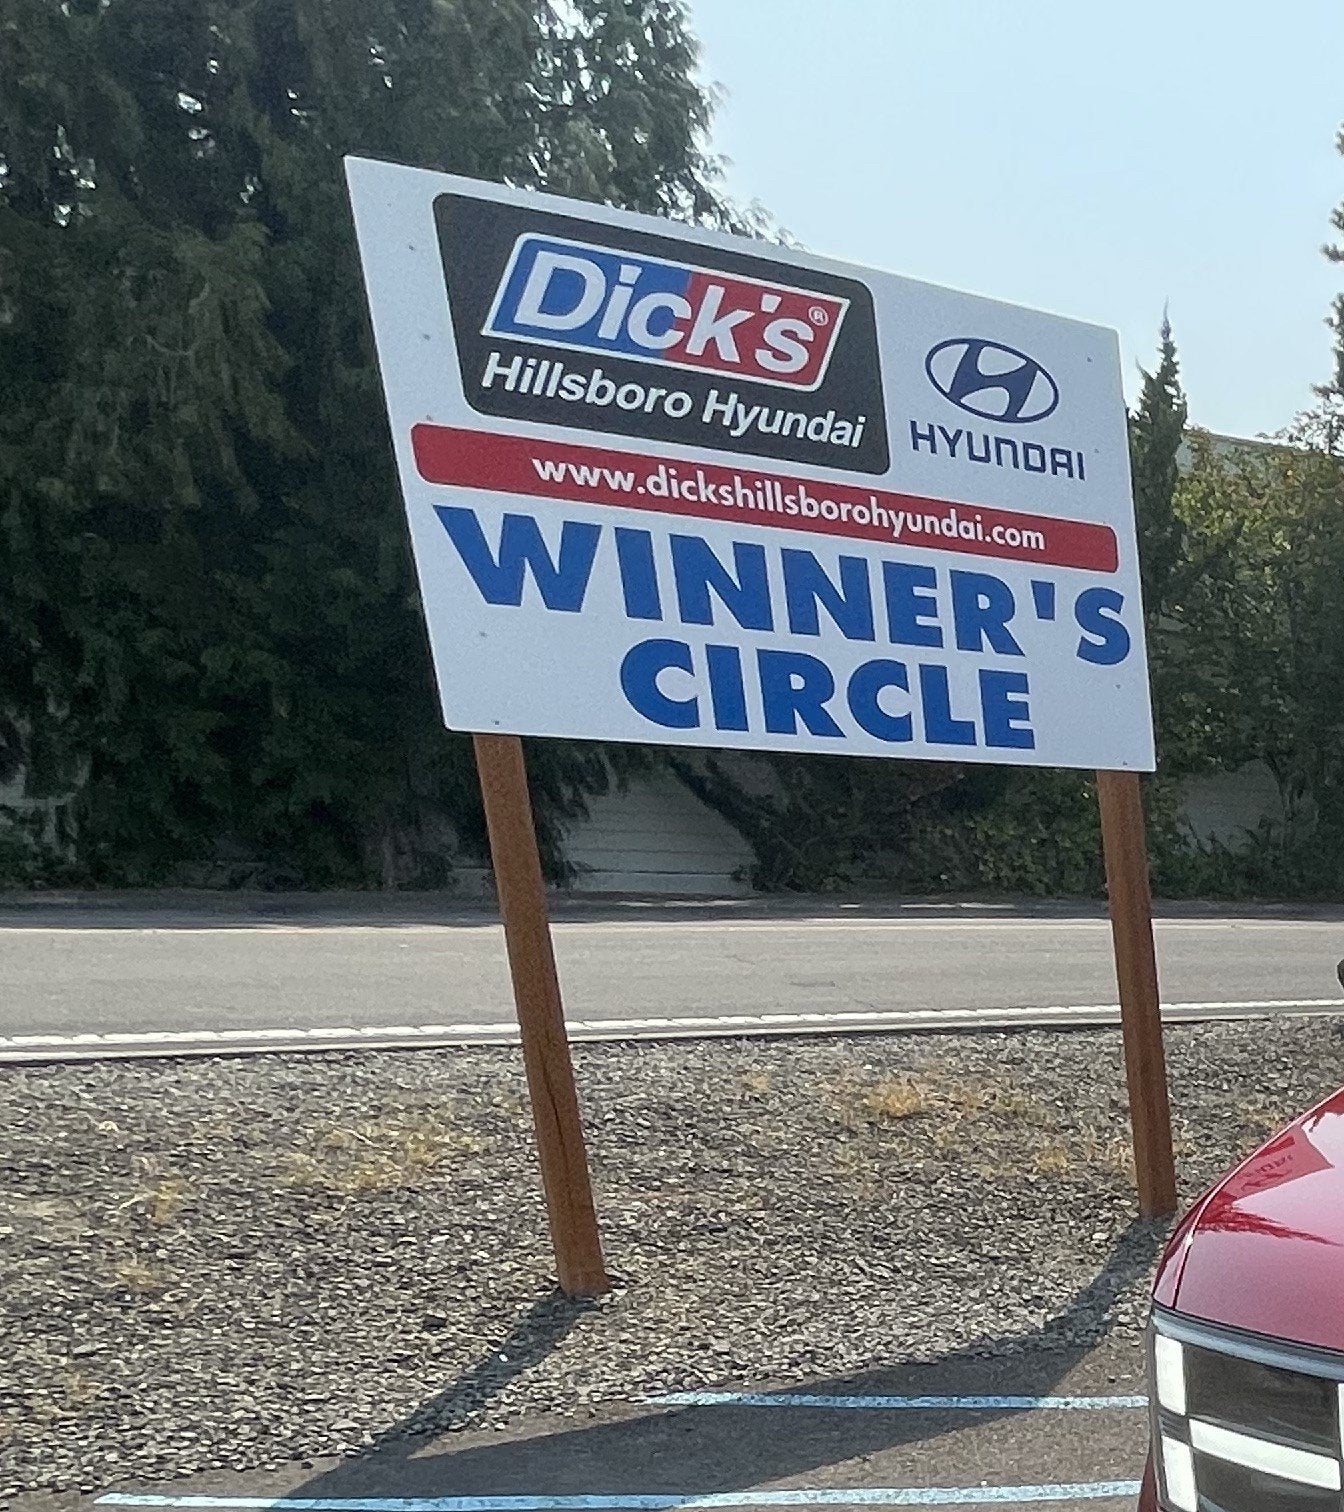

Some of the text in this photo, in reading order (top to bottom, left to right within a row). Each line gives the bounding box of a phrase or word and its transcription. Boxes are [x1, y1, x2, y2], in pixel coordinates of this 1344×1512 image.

[482, 352, 867, 449] Hillsboro Hyundai
[910, 420, 1087, 482] HYUNDAI
[532, 455, 1046, 553] www.dickshillsborohyundai.com
[434, 505, 1132, 667] WINNER'S
[619, 637, 1036, 751] CIRCLE
